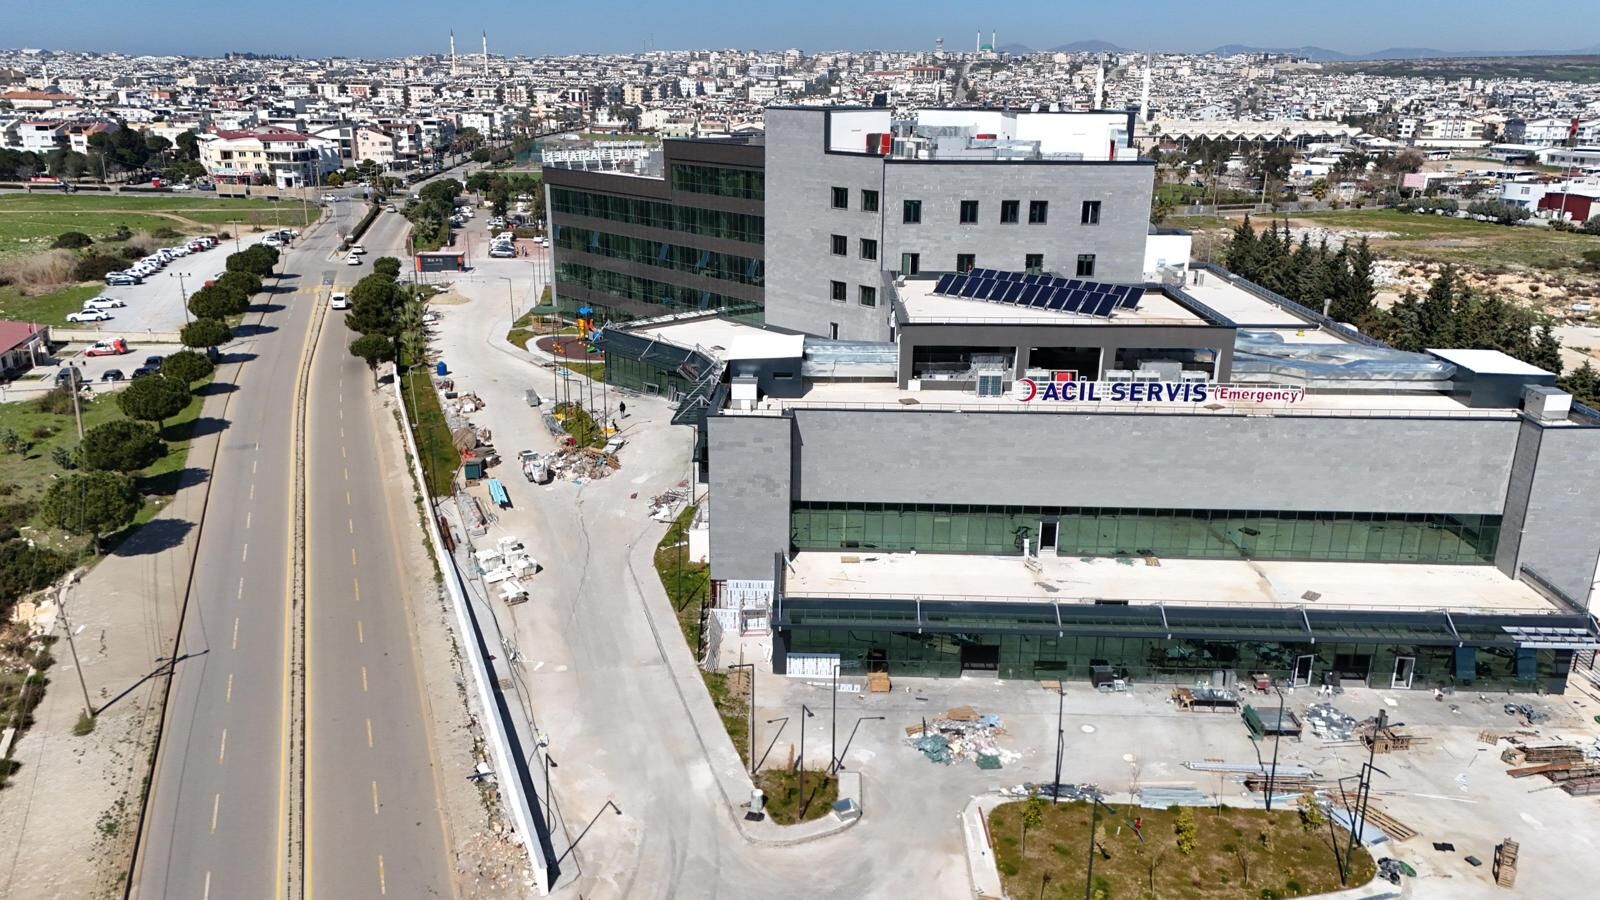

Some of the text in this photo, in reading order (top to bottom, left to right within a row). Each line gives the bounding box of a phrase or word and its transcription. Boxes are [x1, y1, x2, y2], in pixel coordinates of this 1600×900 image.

[1042, 376, 1305, 403] ACİL SERVİS (Emergency)
